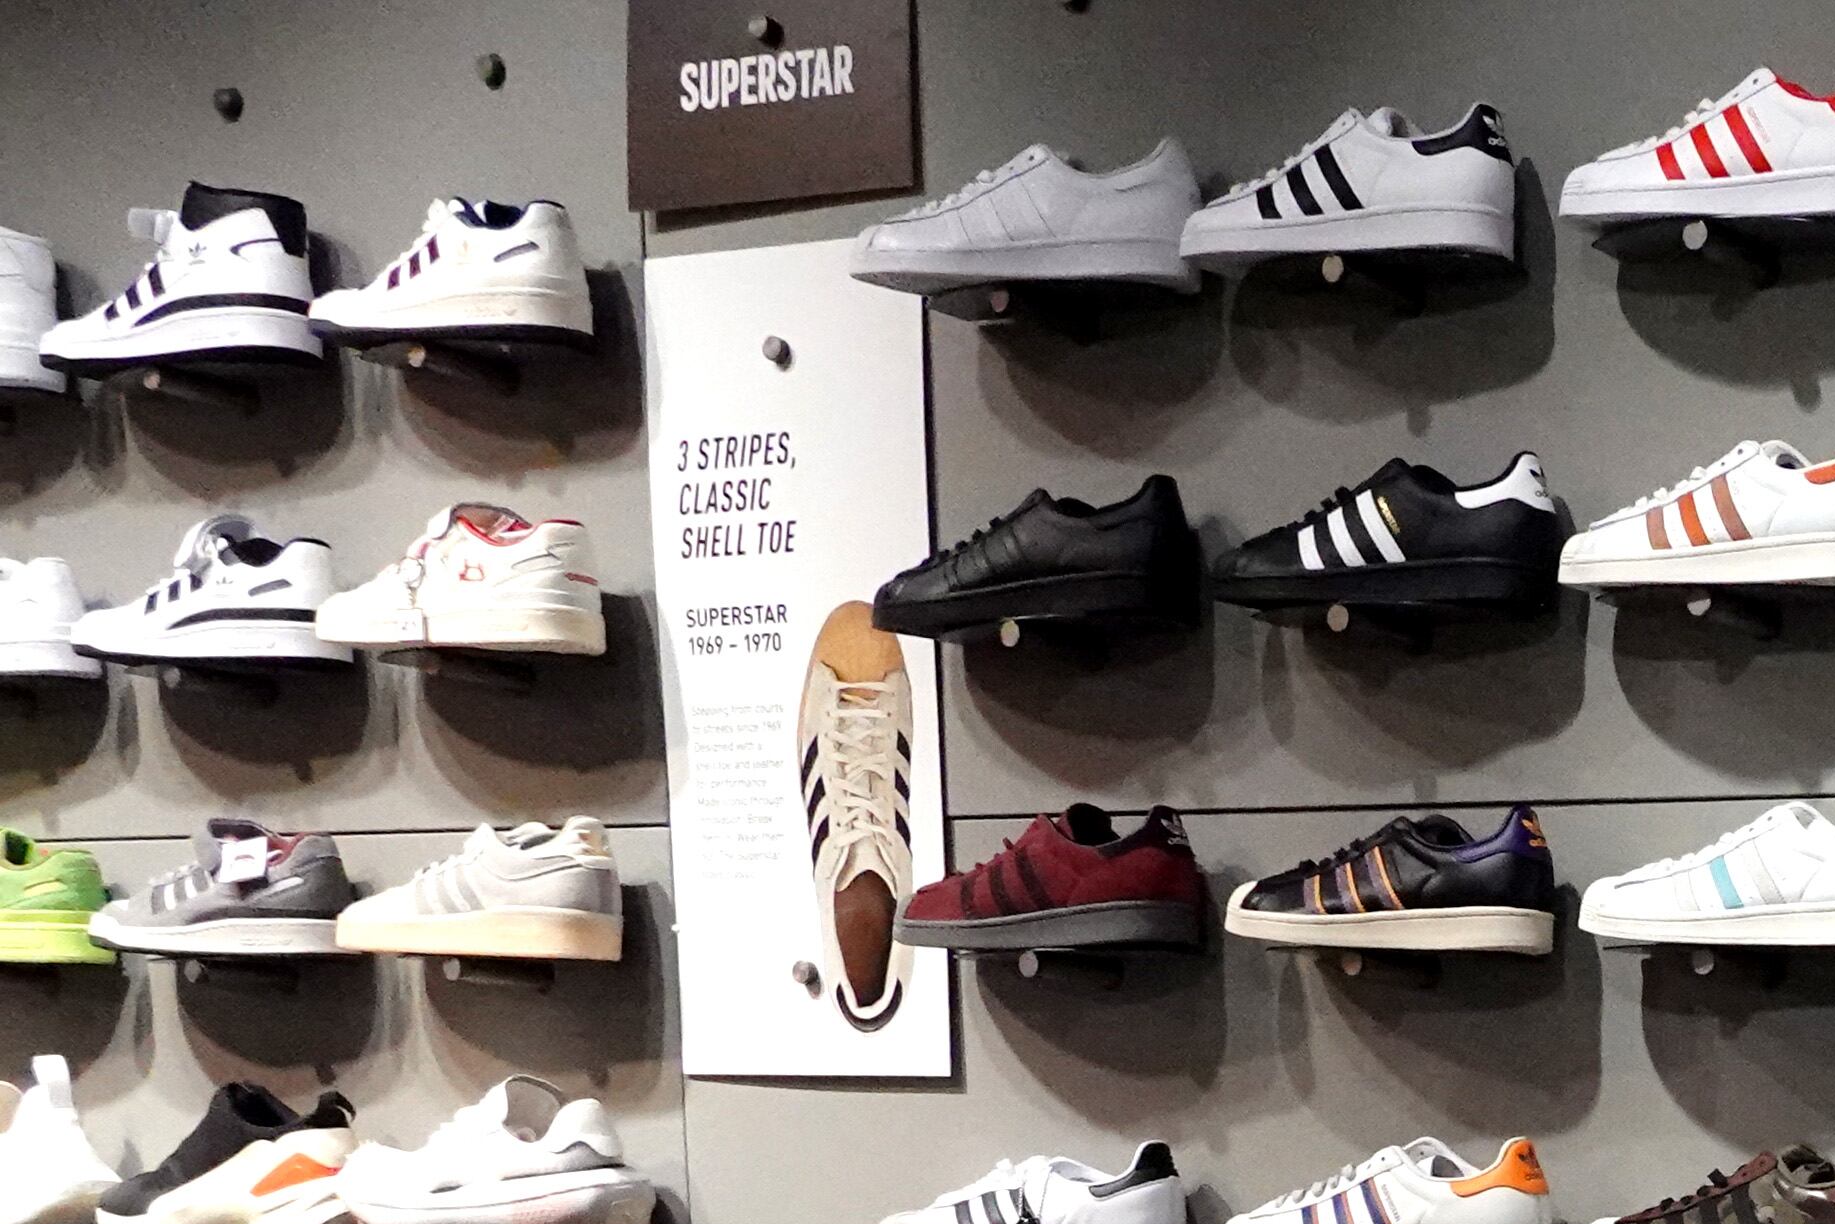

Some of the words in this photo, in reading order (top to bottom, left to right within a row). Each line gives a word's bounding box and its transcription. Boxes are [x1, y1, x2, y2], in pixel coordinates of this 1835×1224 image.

[680, 44, 854, 113] SUPERSTAR
[677, 440, 689, 472] 3
[697, 431, 796, 470] STRIPES,
[679, 478, 772, 515] CLASSIC
[681, 524, 746, 559] SHELL
[758, 520, 797, 554] TOE
[686, 604, 788, 628] SUPERSTAR
[688, 636, 723, 655] 1969
[745, 632, 782, 653] 1970
